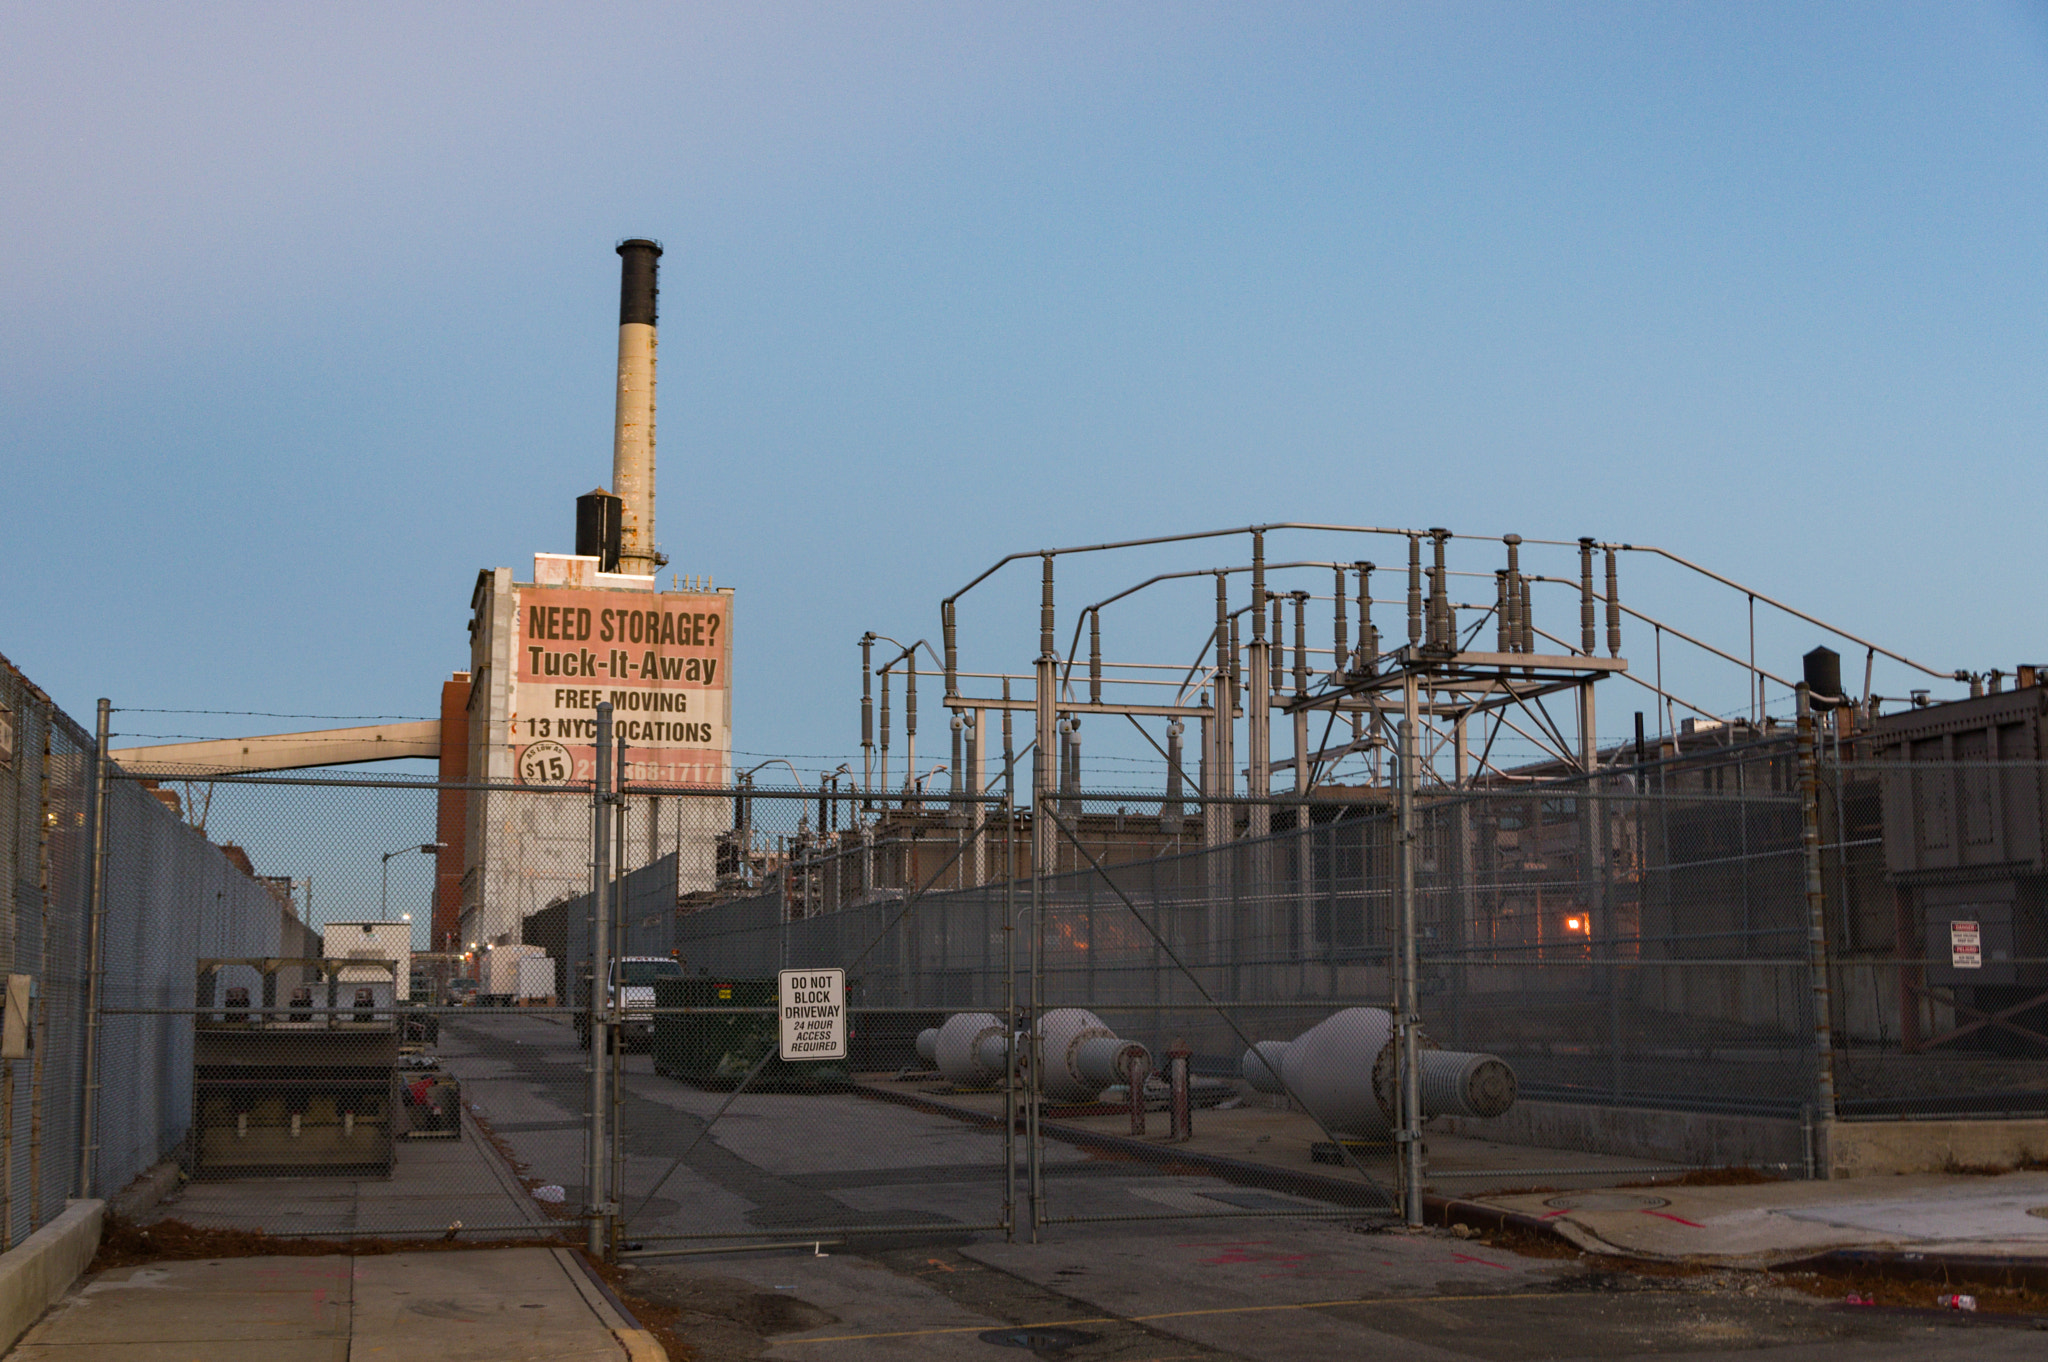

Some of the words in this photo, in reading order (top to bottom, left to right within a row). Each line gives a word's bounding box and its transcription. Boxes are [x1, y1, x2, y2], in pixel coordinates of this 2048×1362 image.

[528, 605, 591, 641] NEED
[600, 608, 720, 647] STORAGE?
[528, 646, 717, 685] Tuck-It-Away
[555, 689, 602, 709] FREE
[610, 691, 687, 713] MOVING
[527, 718, 550, 737] 13
[557, 718, 597, 738] NYC
[611, 720, 712, 742] OCATIONS
[526, 757, 564, 783] $15
[792, 977, 807, 989] DO
[811, 976, 832, 989] NOT
[795, 991, 830, 1004] BLOCK
[785, 1005, 840, 1019] DRIVEWAY
[794, 1021, 805, 1030] 24
[807, 1020, 833, 1030] HOUR
[796, 1031, 831, 1041] ACCESS
[791, 1041, 837, 1052] REQUIRED
